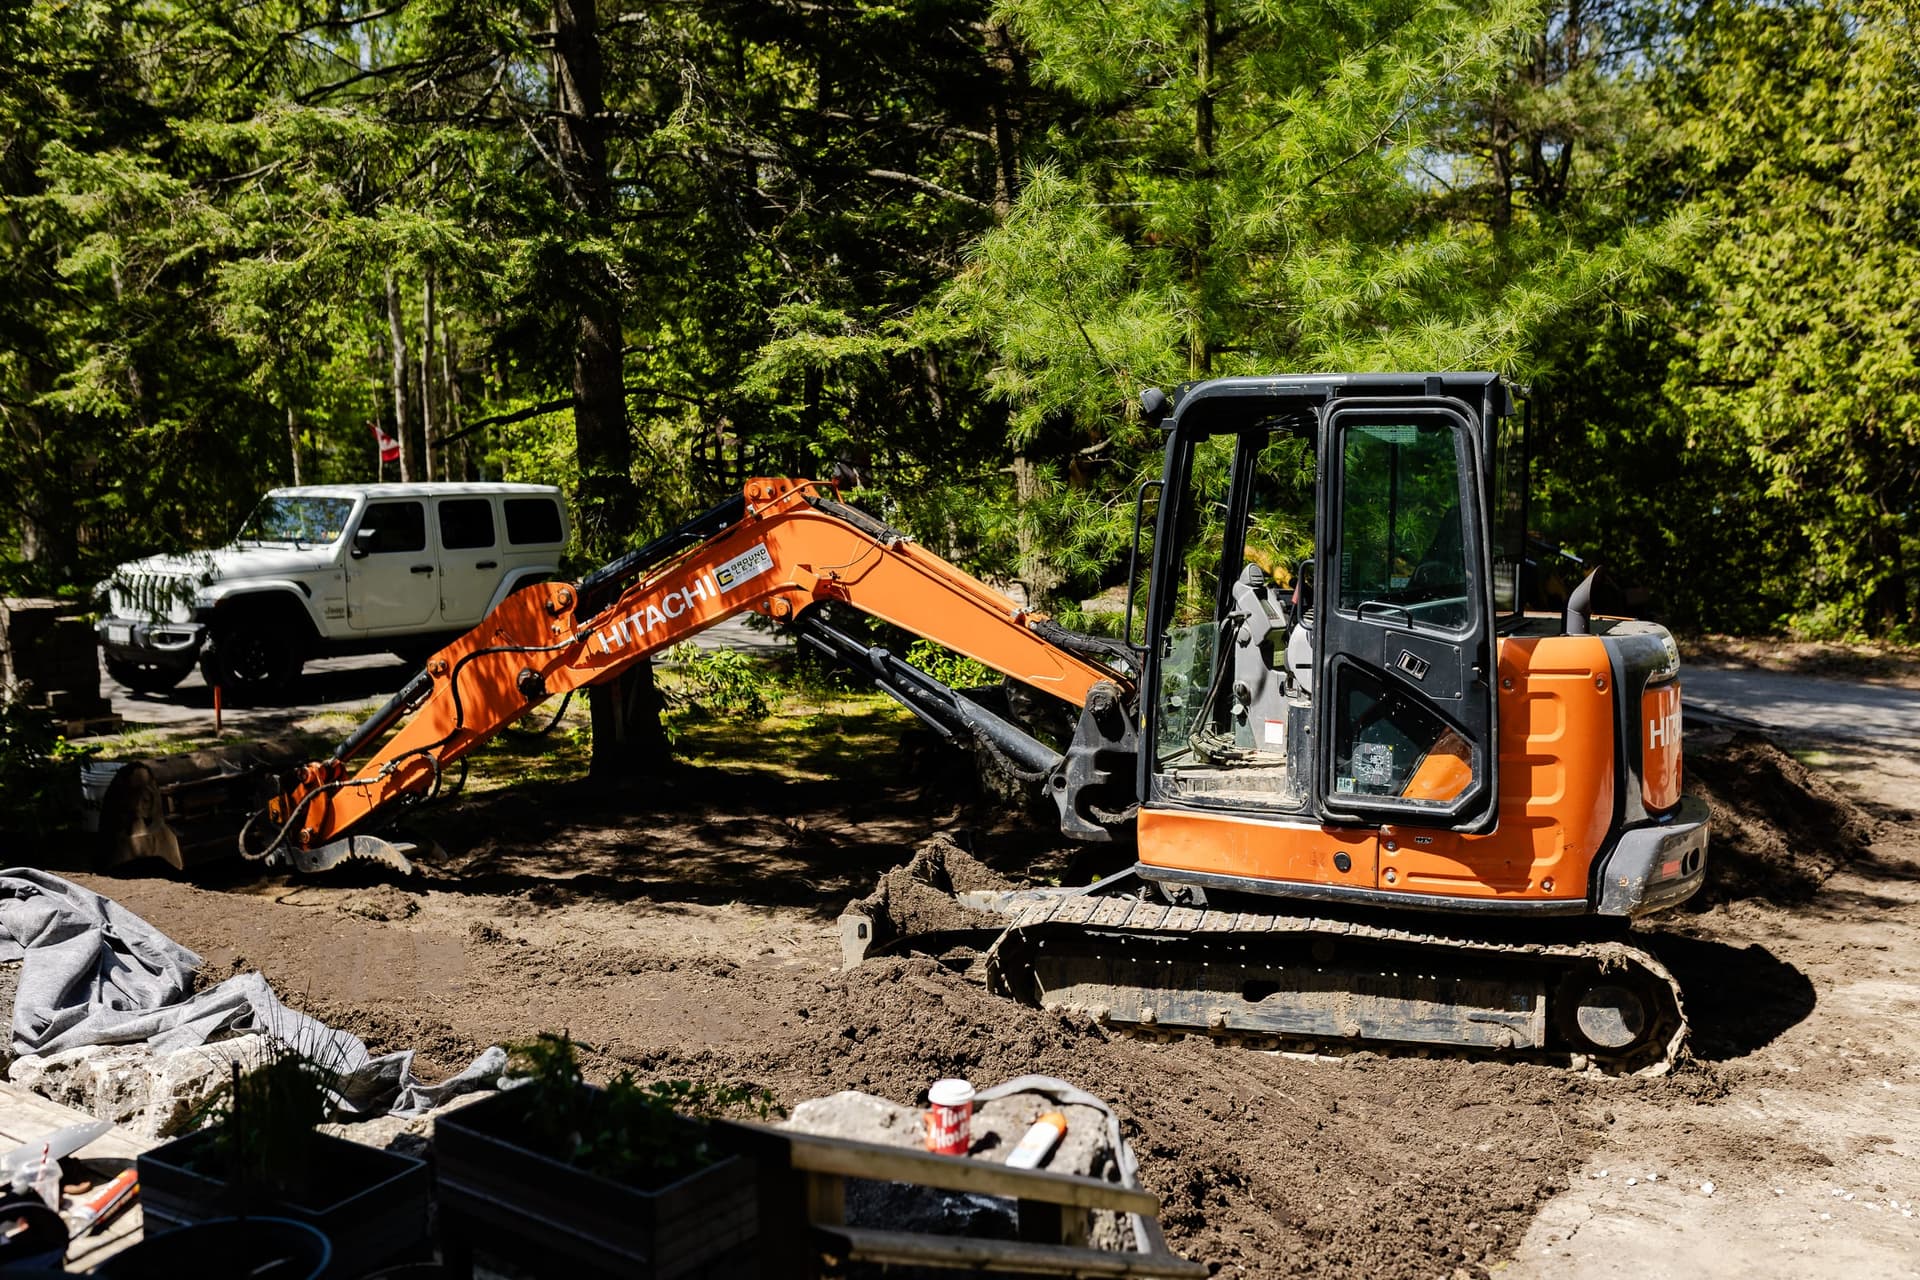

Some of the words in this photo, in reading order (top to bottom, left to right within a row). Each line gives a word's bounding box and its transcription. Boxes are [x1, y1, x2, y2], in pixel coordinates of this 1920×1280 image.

[730, 548, 767, 571] GROUND
[735, 556, 767, 575] LEVEL
[597, 575, 717, 655] HITACHI
[1650, 712, 1682, 750] HIT
[936, 1107, 967, 1128] Tim
